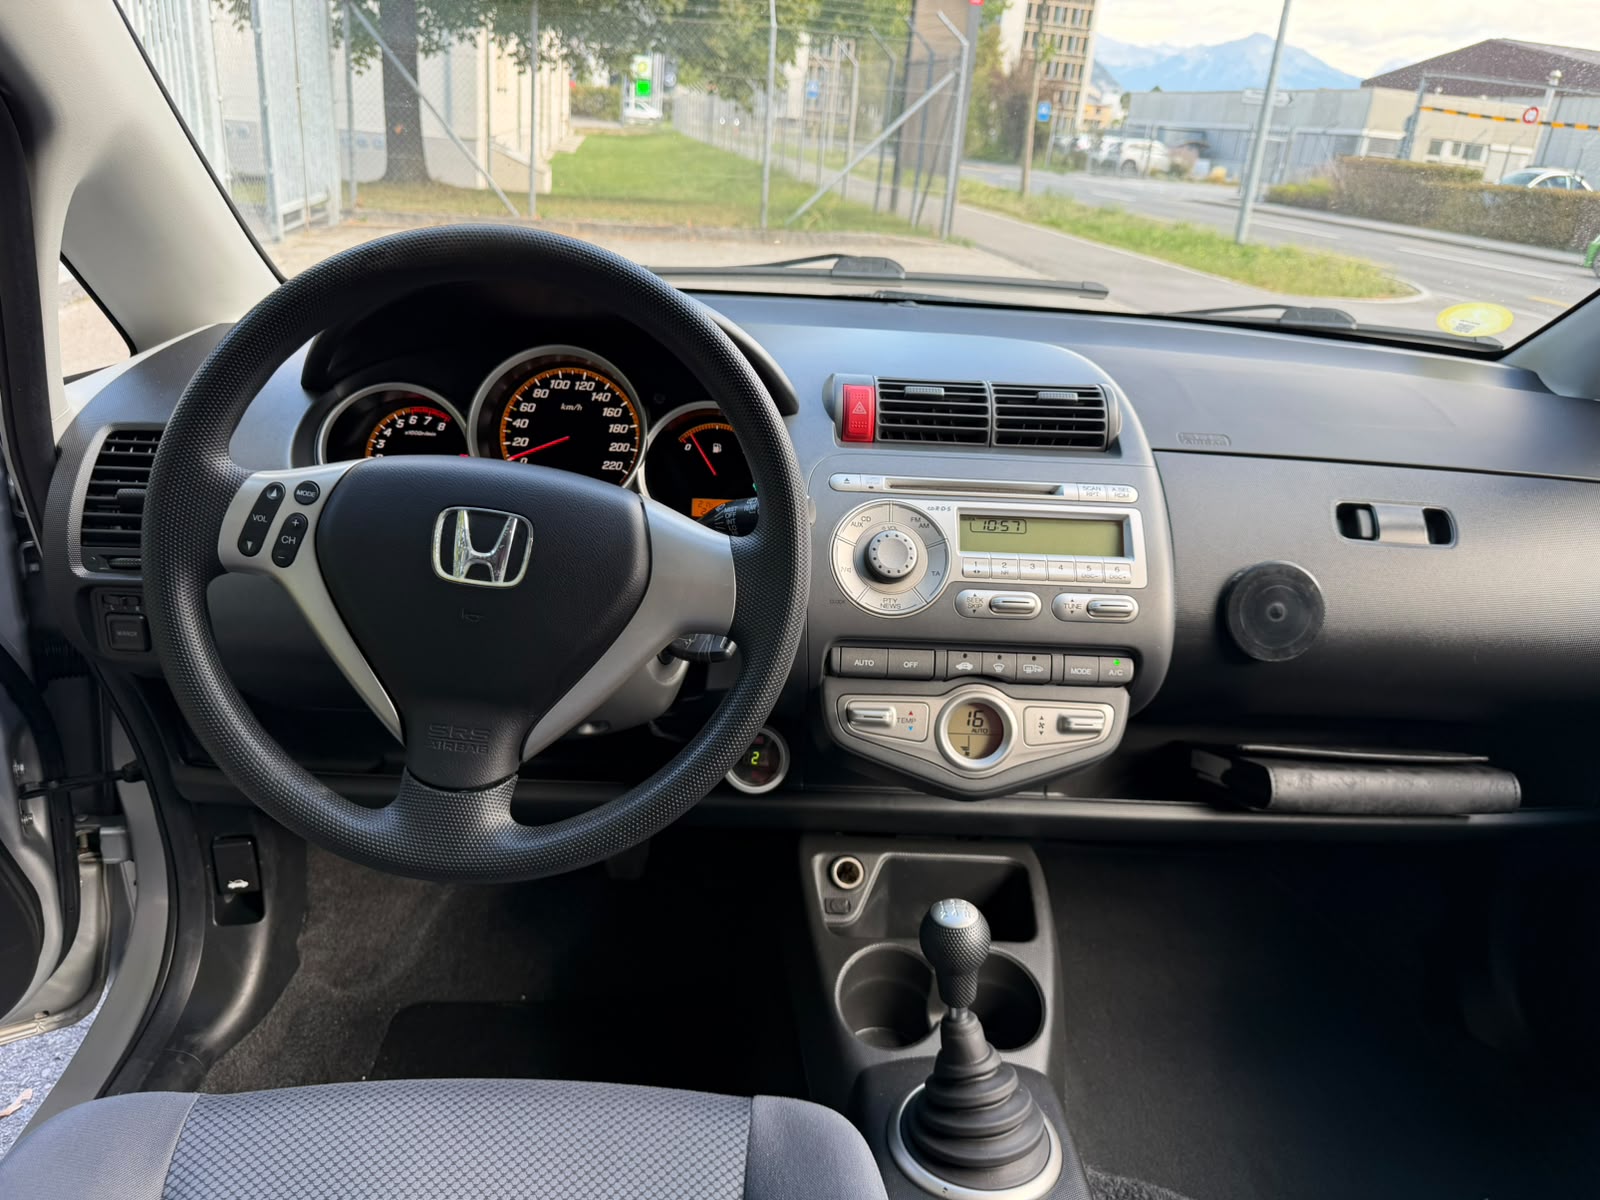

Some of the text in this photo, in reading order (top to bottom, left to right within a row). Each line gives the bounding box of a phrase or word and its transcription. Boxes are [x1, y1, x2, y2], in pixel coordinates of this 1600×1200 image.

[550, 380, 570, 389] 100
[575, 381, 595, 390] 120
[533, 389, 549, 398] 80
[591, 392, 611, 401] 140
[520, 403, 536, 412] 60
[561, 403, 583, 411] km/h
[602, 407, 622, 417] 160
[396, 419, 405, 428] 5
[409, 416, 418, 424] 6
[424, 416, 432, 425] 7
[512, 419, 529, 428] 40
[437, 422, 446, 431] 8
[609, 424, 628, 433] 180
[383, 428, 392, 437] 4
[376, 439, 386, 448] 3
[512, 437, 529, 447] 20
[609, 442, 630, 452] 200
[602, 461, 623, 471] 220
[296, 489, 316, 498] MODE
[253, 514, 268, 522] VOL
[982, 520, 1021, 532] 10:57
[281, 535, 296, 544] CH
[854, 658, 875, 667] AUTO
[903, 660, 919, 669] OFF
[1070, 667, 1093, 676] MODE
[1108, 668, 1124, 677] A/C
[896, 716, 917, 724] TEMP
[966, 710, 984, 728] 16
[427, 723, 491, 740] SRS
[751, 752, 760, 765] 2
